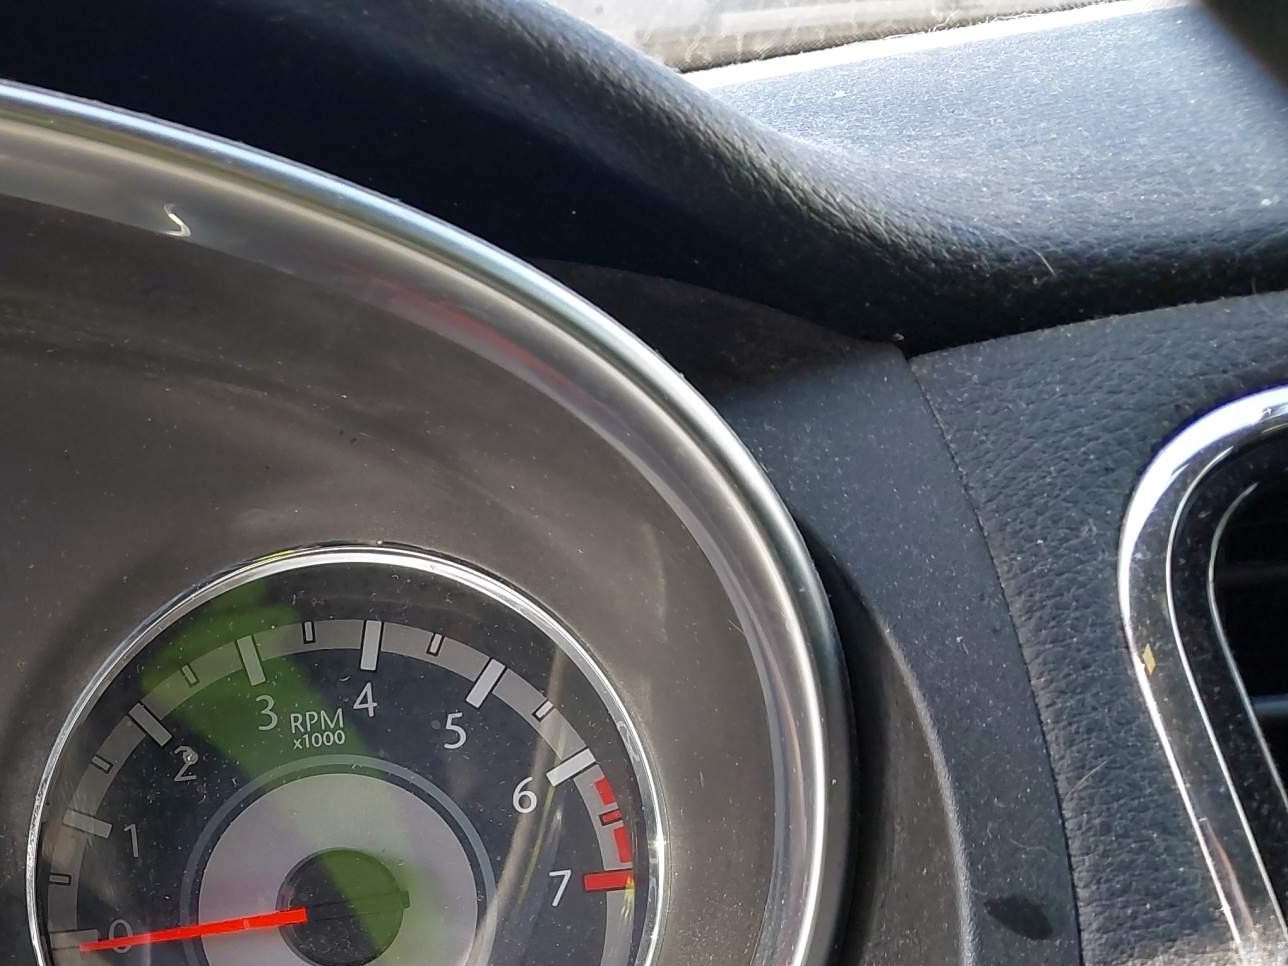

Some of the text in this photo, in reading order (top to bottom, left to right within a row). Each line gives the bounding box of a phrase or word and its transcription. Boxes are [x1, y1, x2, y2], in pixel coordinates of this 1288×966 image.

[255, 695, 279, 731] 3
[352, 682, 378, 717] 4
[289, 708, 345, 734] RPM
[444, 713, 468, 750] 5
[293, 729, 346, 750] x1000
[174, 745, 199, 782] 2
[512, 777, 538, 814] 6
[123, 824, 139, 858] 1
[549, 869, 572, 907] 7
[108, 919, 133, 954] 0
